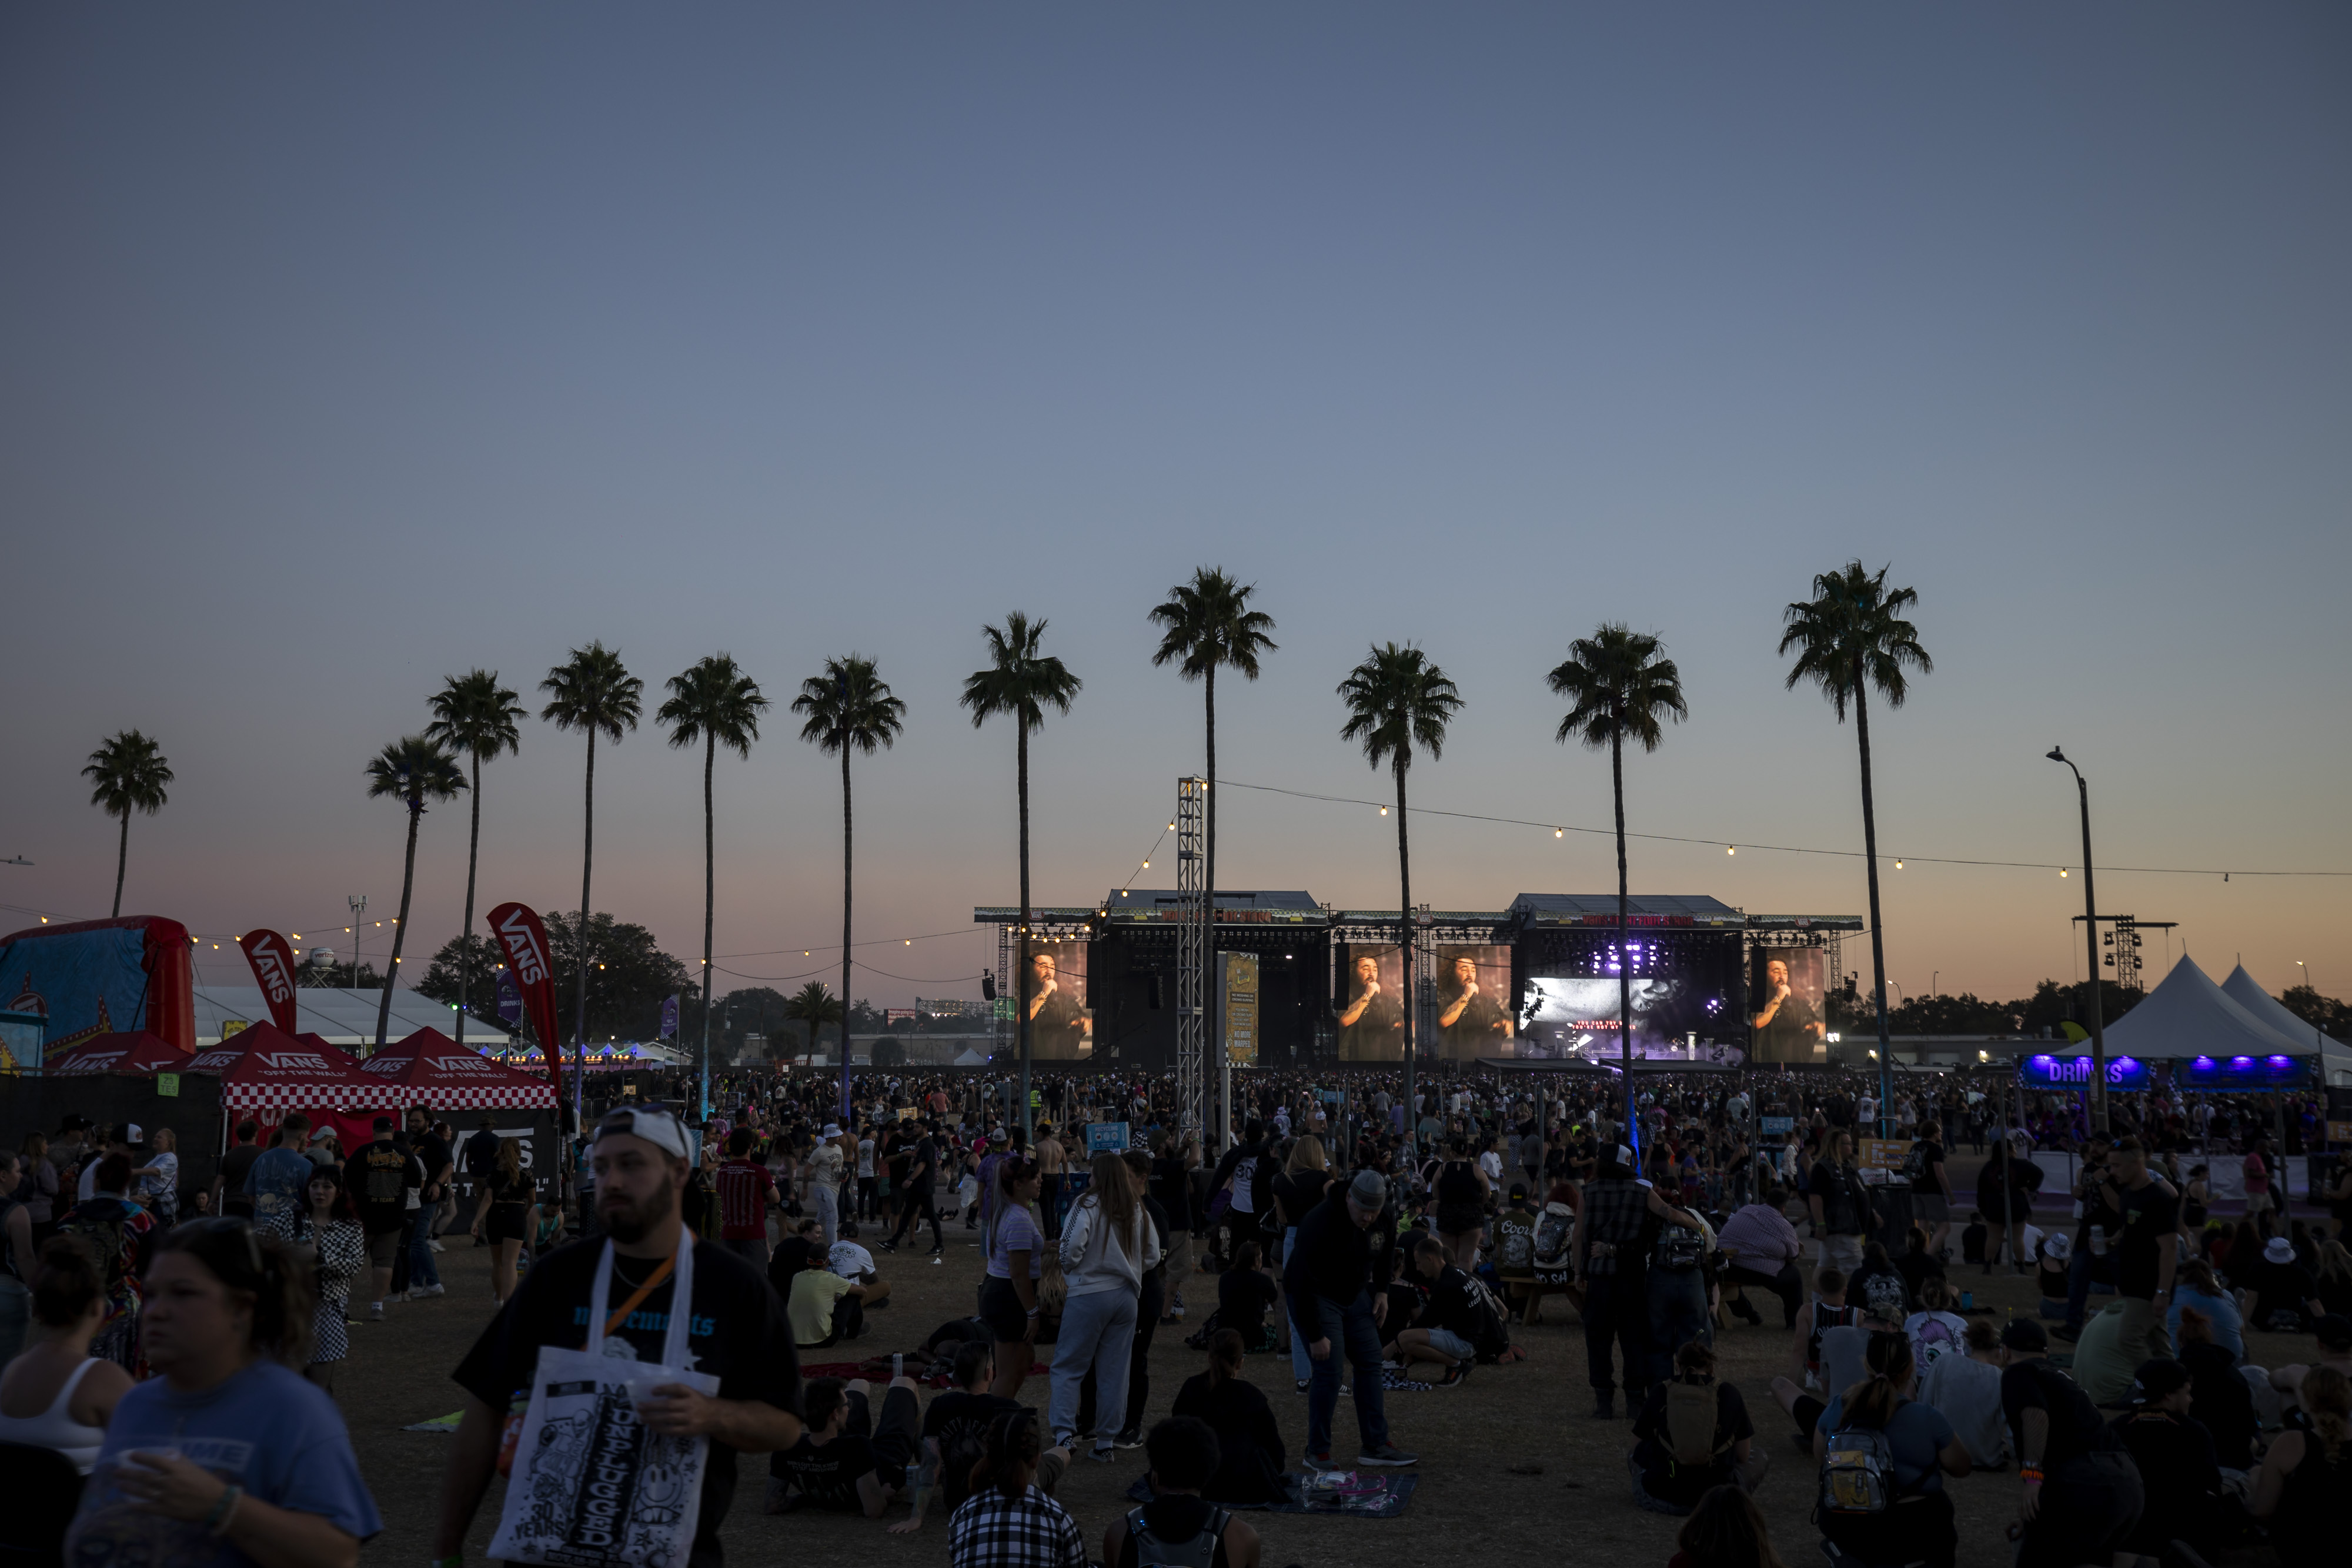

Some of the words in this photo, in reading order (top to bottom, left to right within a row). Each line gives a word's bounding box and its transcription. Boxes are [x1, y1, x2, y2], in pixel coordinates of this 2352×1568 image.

[1419, 914, 1431, 922] VANS
[500, 908, 550, 985] VANS
[251, 934, 294, 1004] VANS
[1234, 1030, 1240, 1038] NO
[60, 1051, 129, 1070] VANS
[186, 1051, 245, 1068] VANS
[255, 1052, 329, 1069] VANS
[360, 1057, 414, 1072] VANS
[423, 1057, 492, 1071] VANS
[1236, 1164, 1255, 1181] 30
[531, 1501, 554, 1522] 30
[515, 1520, 565, 1540] YEARS
